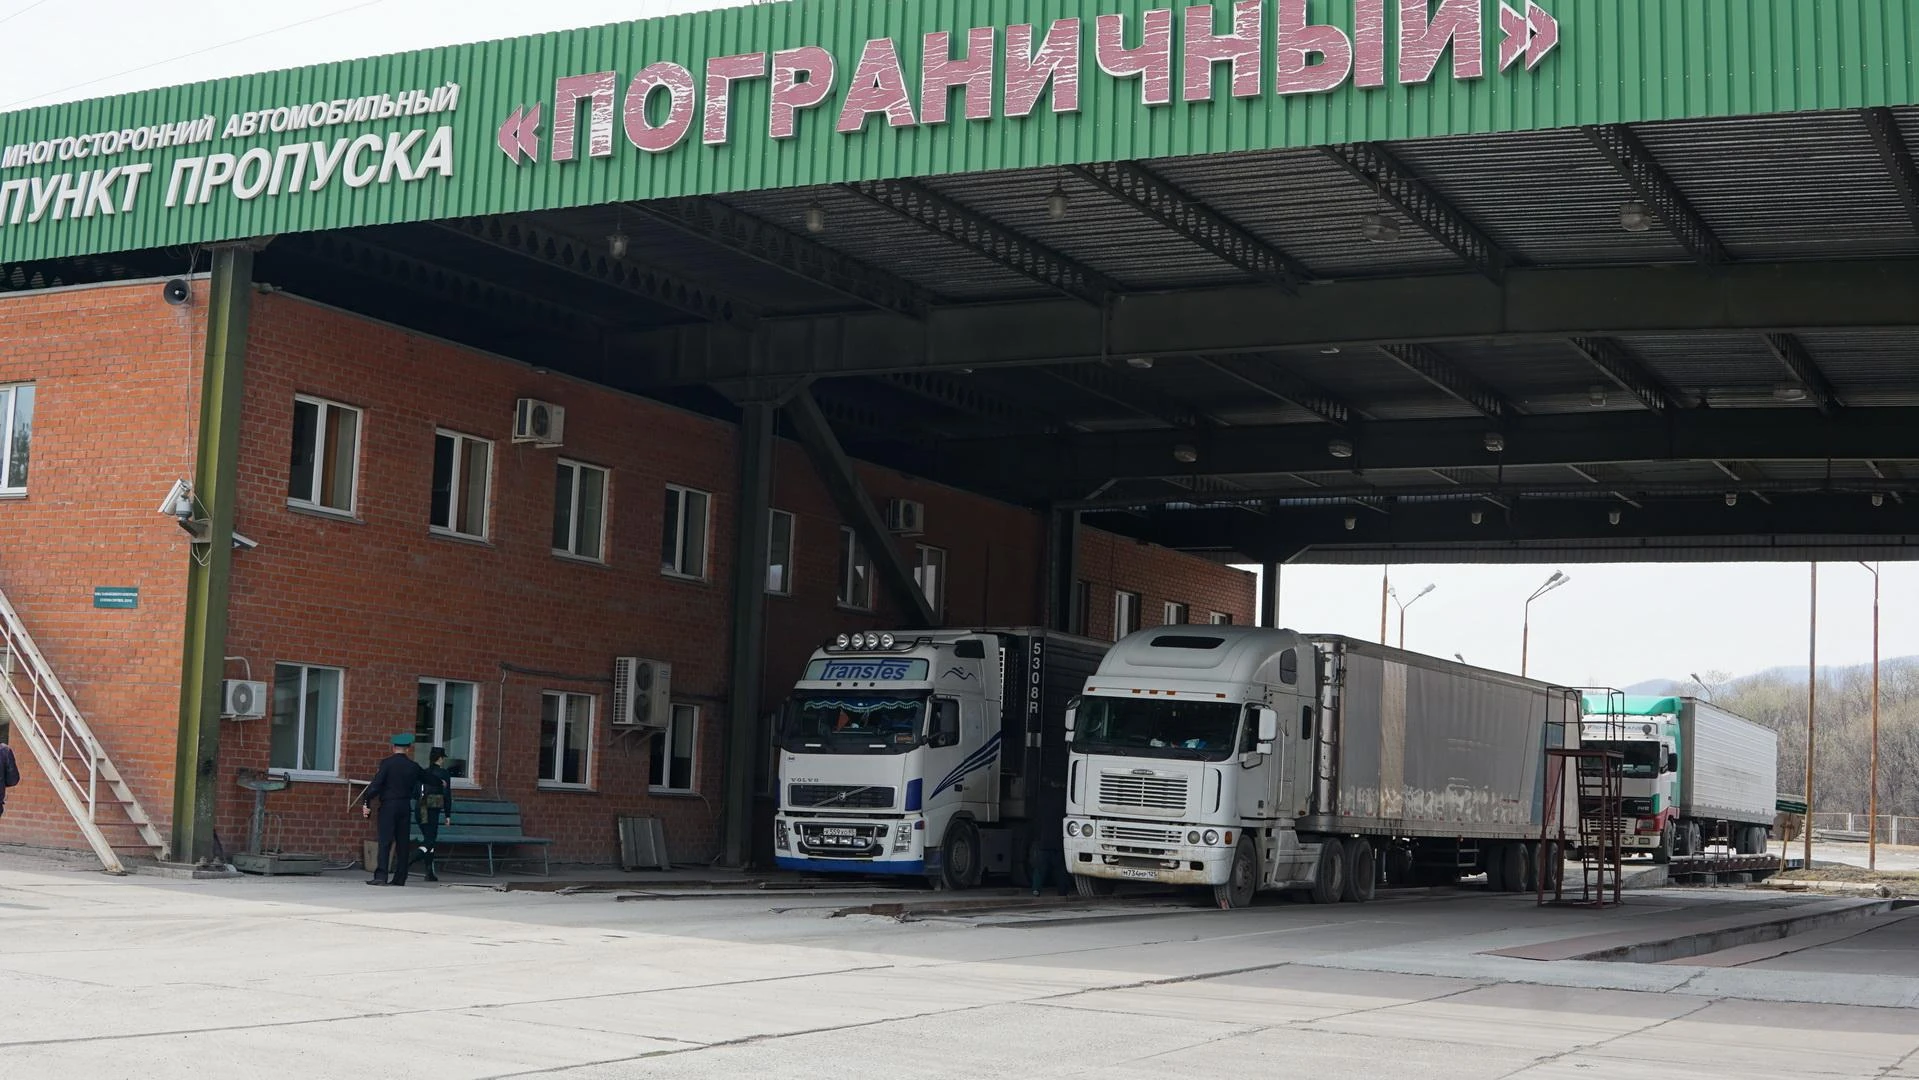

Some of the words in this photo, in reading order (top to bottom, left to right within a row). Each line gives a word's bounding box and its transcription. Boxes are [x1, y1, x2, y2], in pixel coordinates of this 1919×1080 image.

[1, 114, 216, 169] МНОГОСТОРОННИЙ
[221, 81, 461, 139] АВТОМОБИЛЬНЫЙ
[0, 163, 152, 226] ПУНКТ
[164, 125, 454, 207] ПРОПУСКА
[1029, 642, 1042, 714] 5308R
